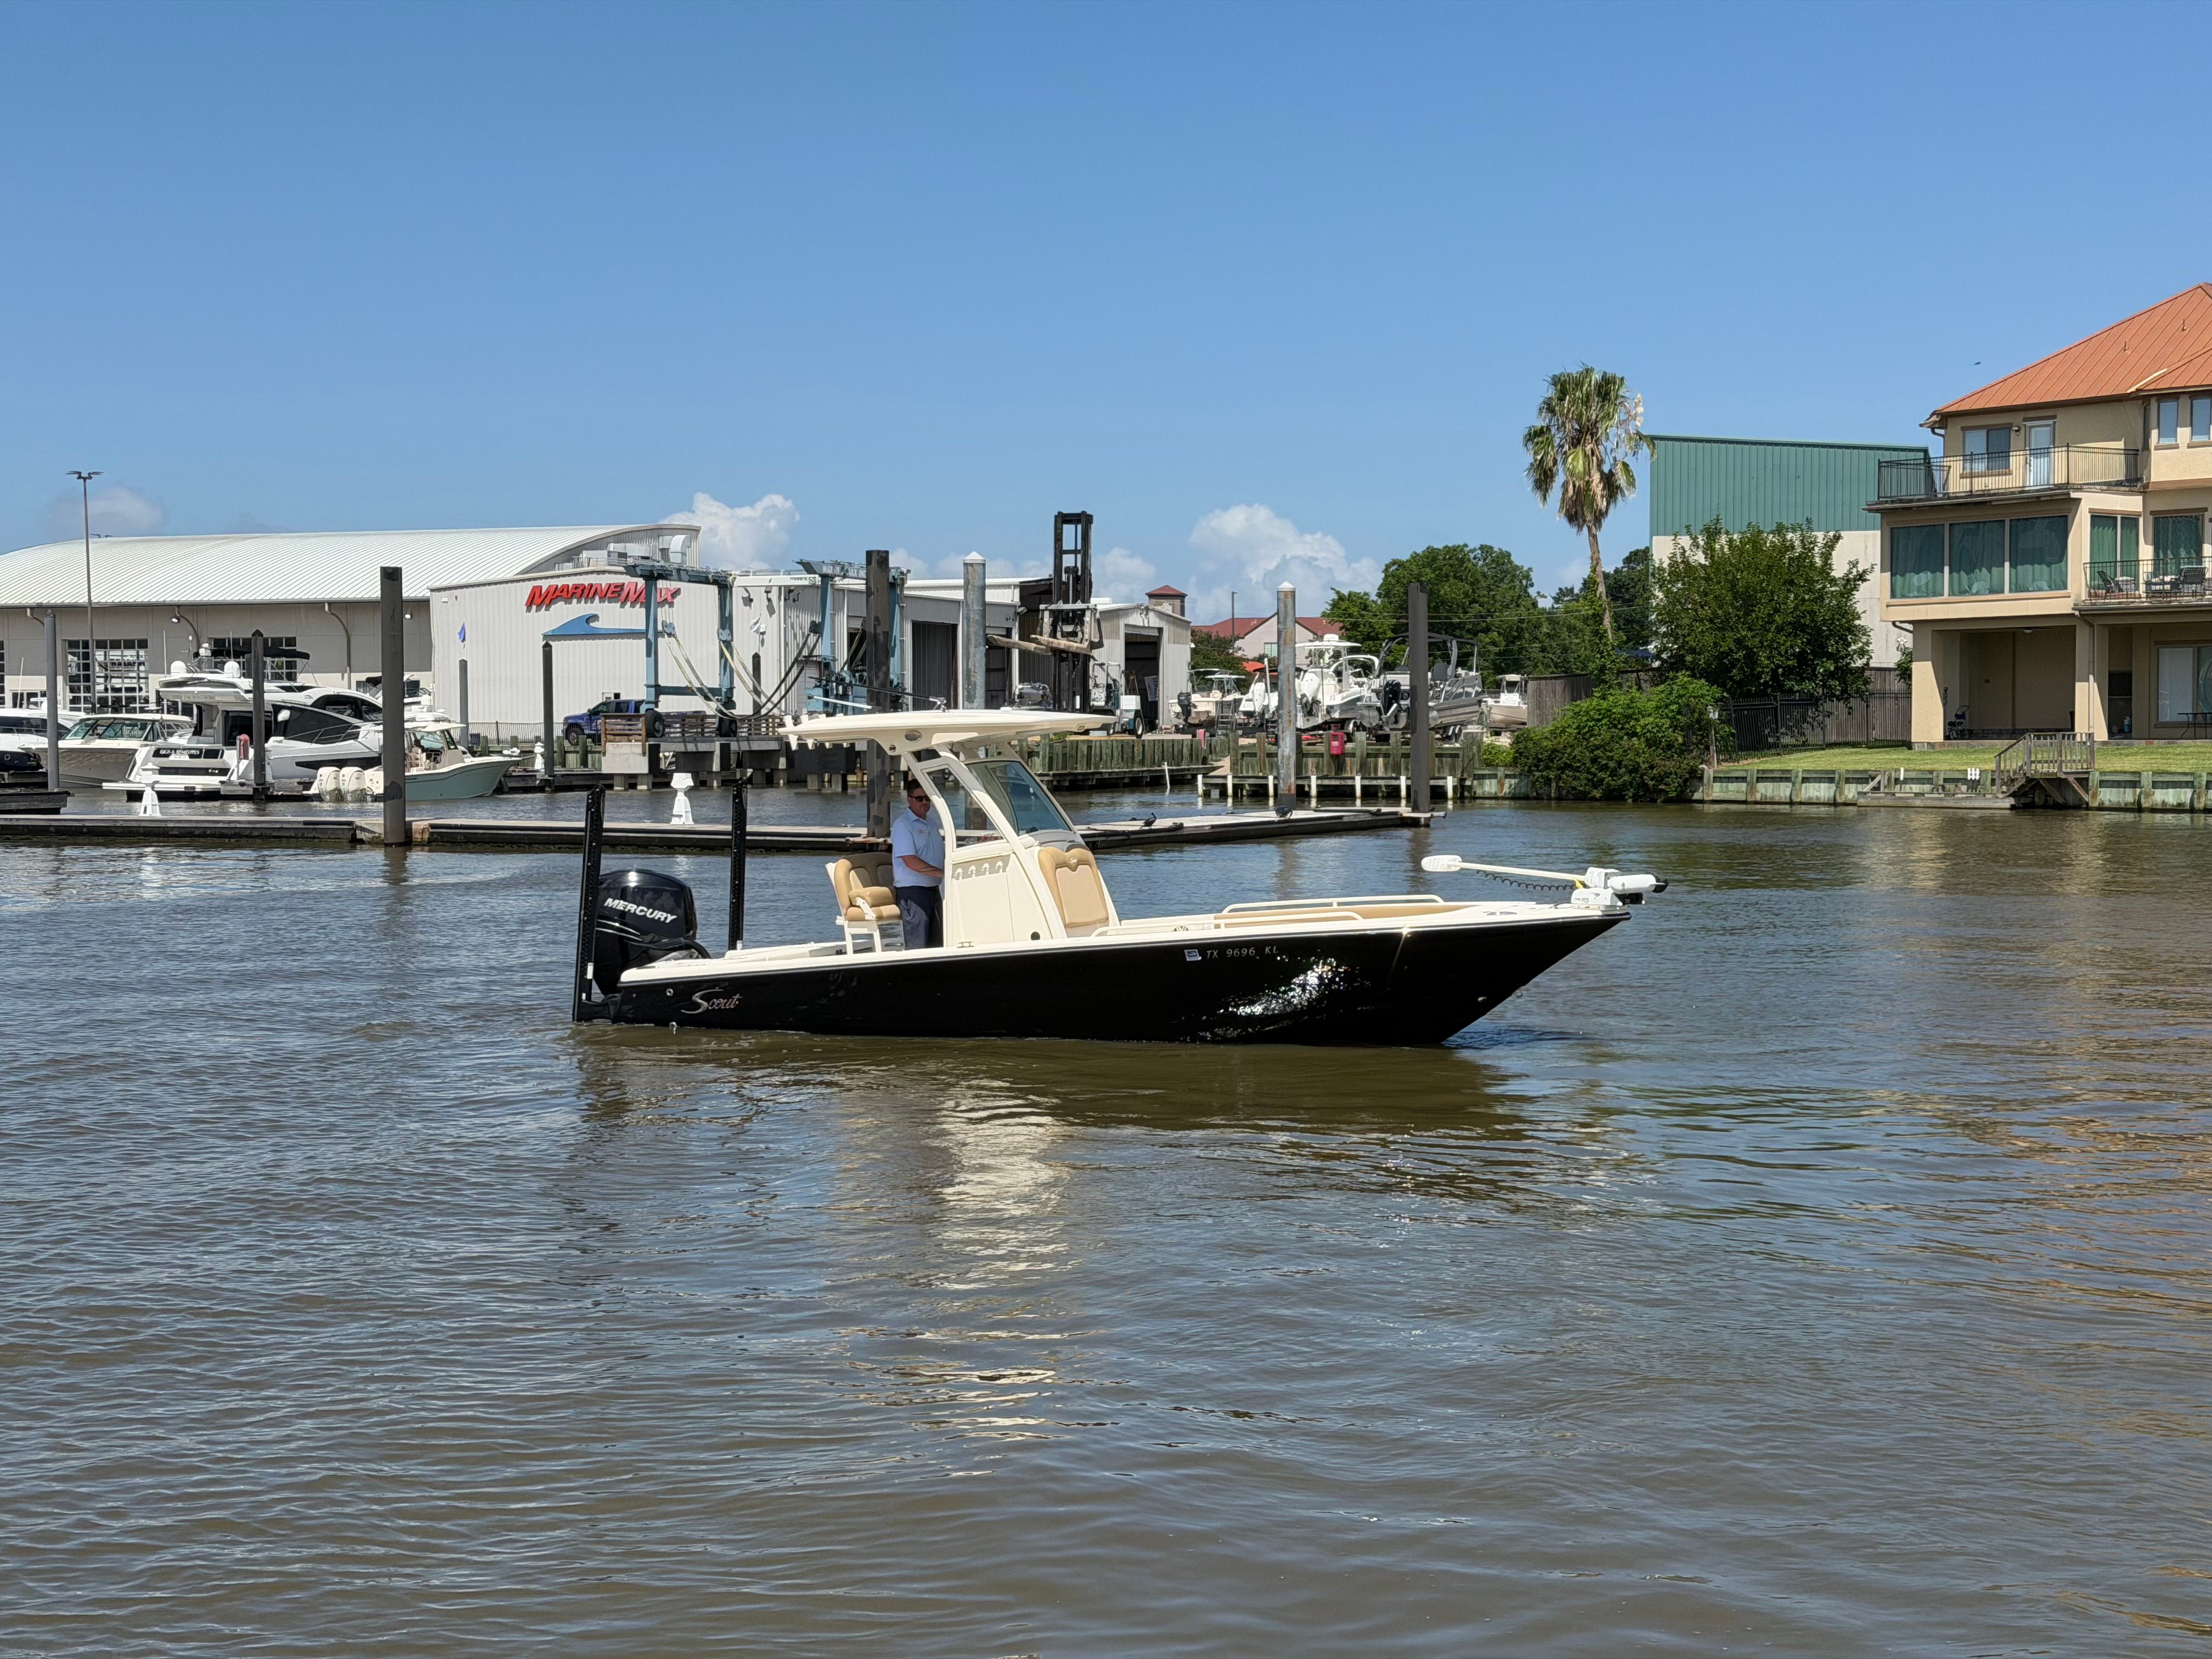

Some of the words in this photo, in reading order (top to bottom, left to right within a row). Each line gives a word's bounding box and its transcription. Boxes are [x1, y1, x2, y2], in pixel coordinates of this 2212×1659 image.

[604, 898, 678, 923] MERCURY
[1206, 949, 1219, 959] TX
[1226, 947, 1256, 957] 9696
[1265, 945, 1279, 955] KL
[680, 989, 743, 1014] Scout
